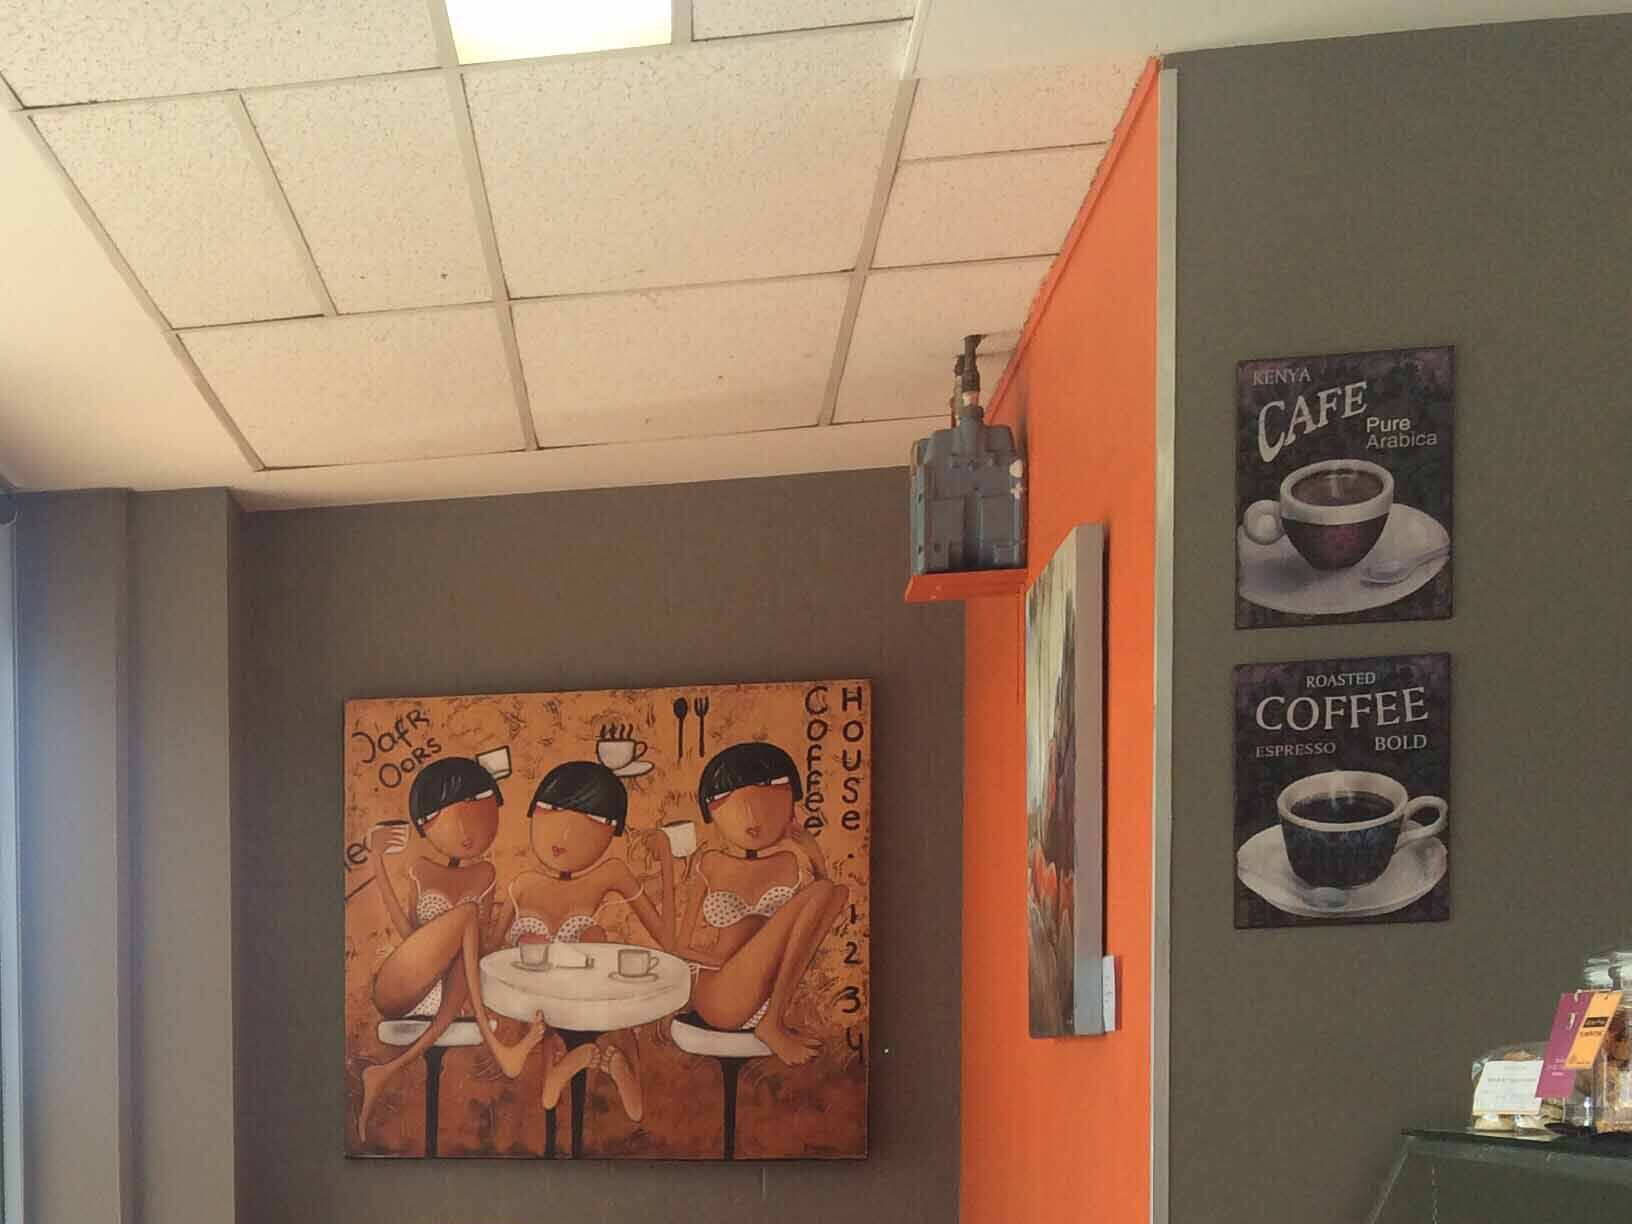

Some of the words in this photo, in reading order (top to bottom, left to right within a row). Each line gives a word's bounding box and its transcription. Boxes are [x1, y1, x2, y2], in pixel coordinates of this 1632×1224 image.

[1253, 367, 1311, 386] KENYA
[1258, 380, 1368, 463] CAFE
[1366, 416, 1411, 433] Pure
[1365, 432, 1438, 449] Arabica
[1306, 671, 1377, 689] ROASTED
[1255, 686, 1430, 731] COFFEE
[1255, 741, 1337, 758] ESPRESSO
[1374, 734, 1428, 751] BOLD
